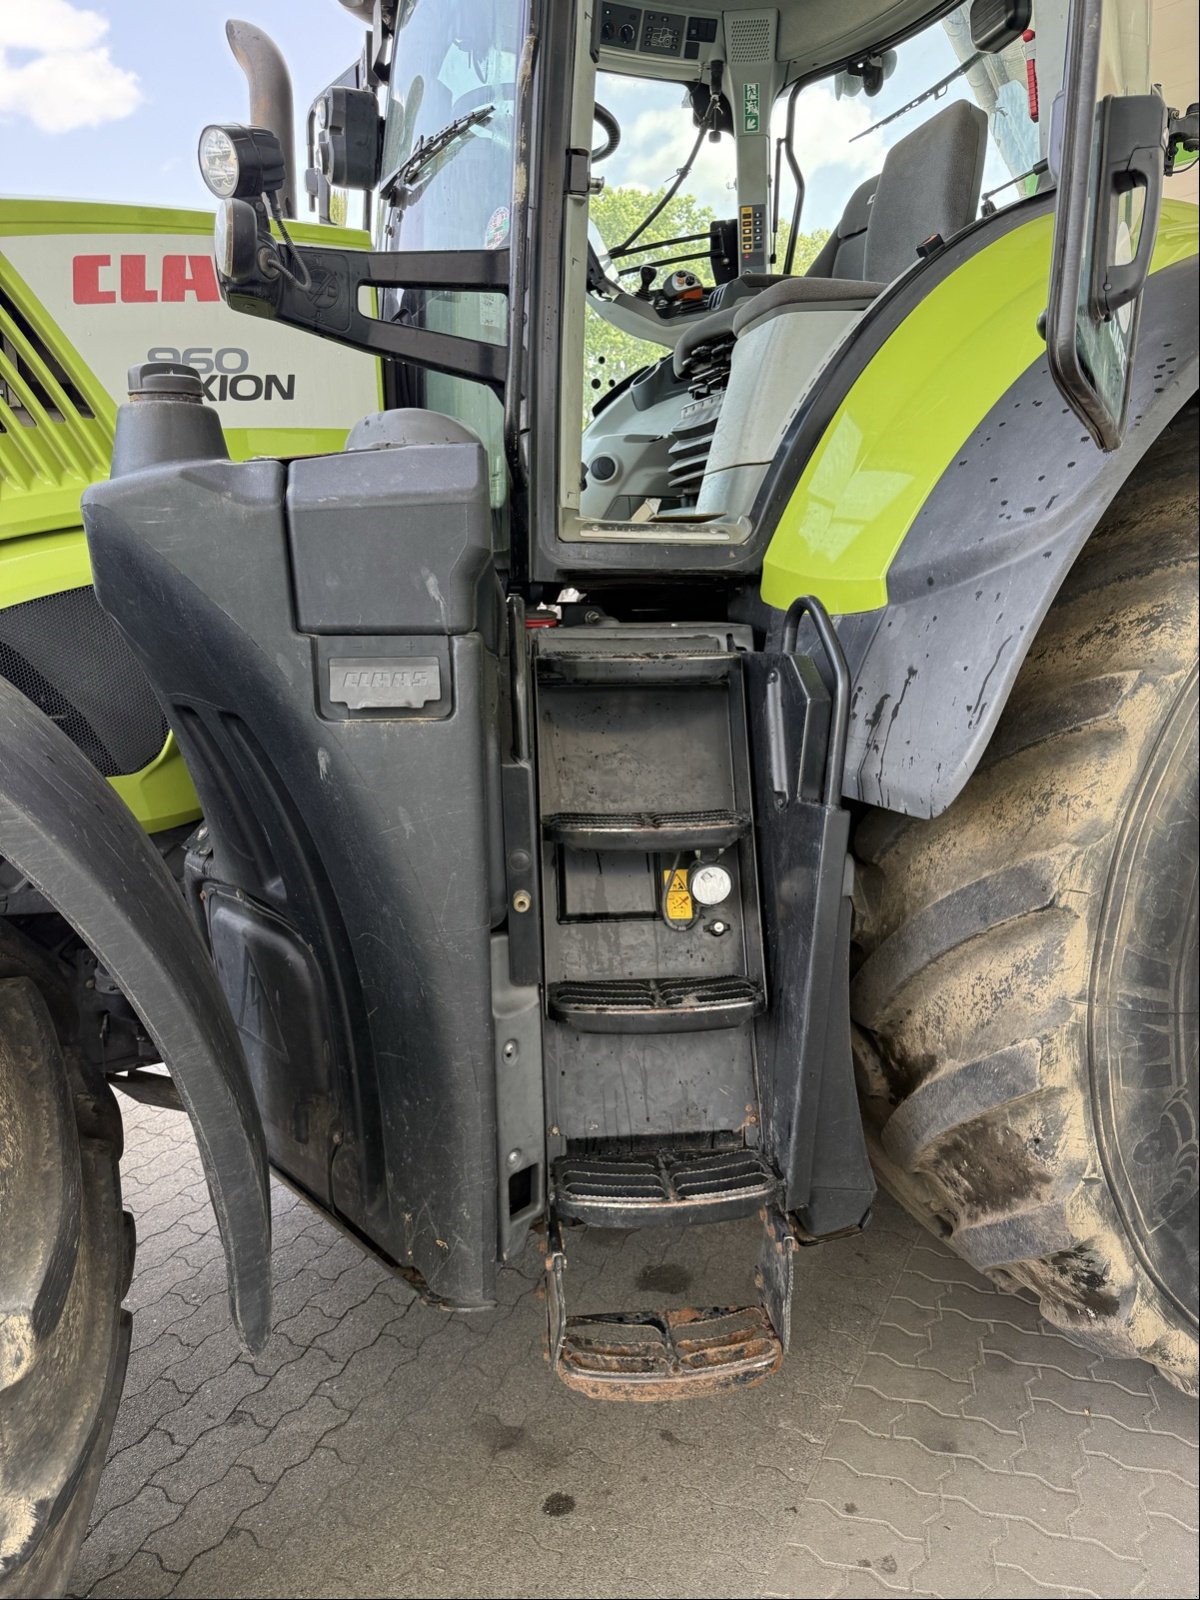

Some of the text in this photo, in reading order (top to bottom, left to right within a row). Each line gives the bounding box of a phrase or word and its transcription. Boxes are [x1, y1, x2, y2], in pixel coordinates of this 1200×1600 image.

[73, 254, 221, 305] CLA
[202, 374, 296, 402] XION
[343, 671, 428, 688] CLAAS
